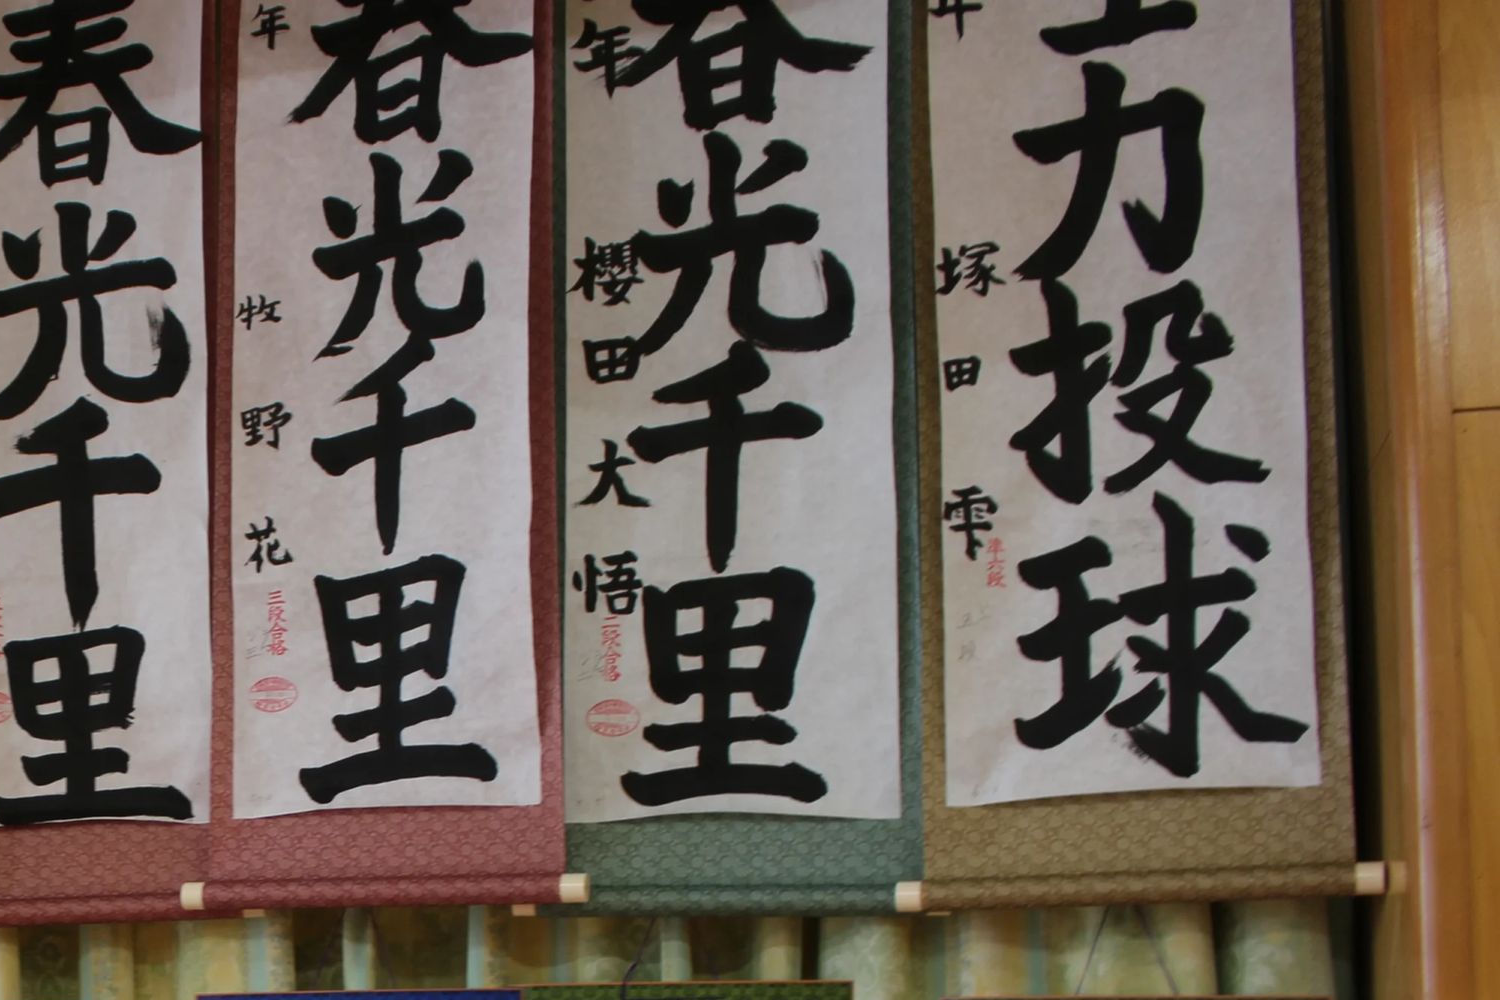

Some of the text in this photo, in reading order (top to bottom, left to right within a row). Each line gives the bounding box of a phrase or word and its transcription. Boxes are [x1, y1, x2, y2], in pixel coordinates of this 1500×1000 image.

[236, 294, 294, 574] 牧野花
[288, 0, 533, 803] 春光千里
[566, 236, 652, 617] 櫻田大悟
[933, 242, 1008, 562] 塚田雫
[1008, 0, 1310, 778] 力投球
